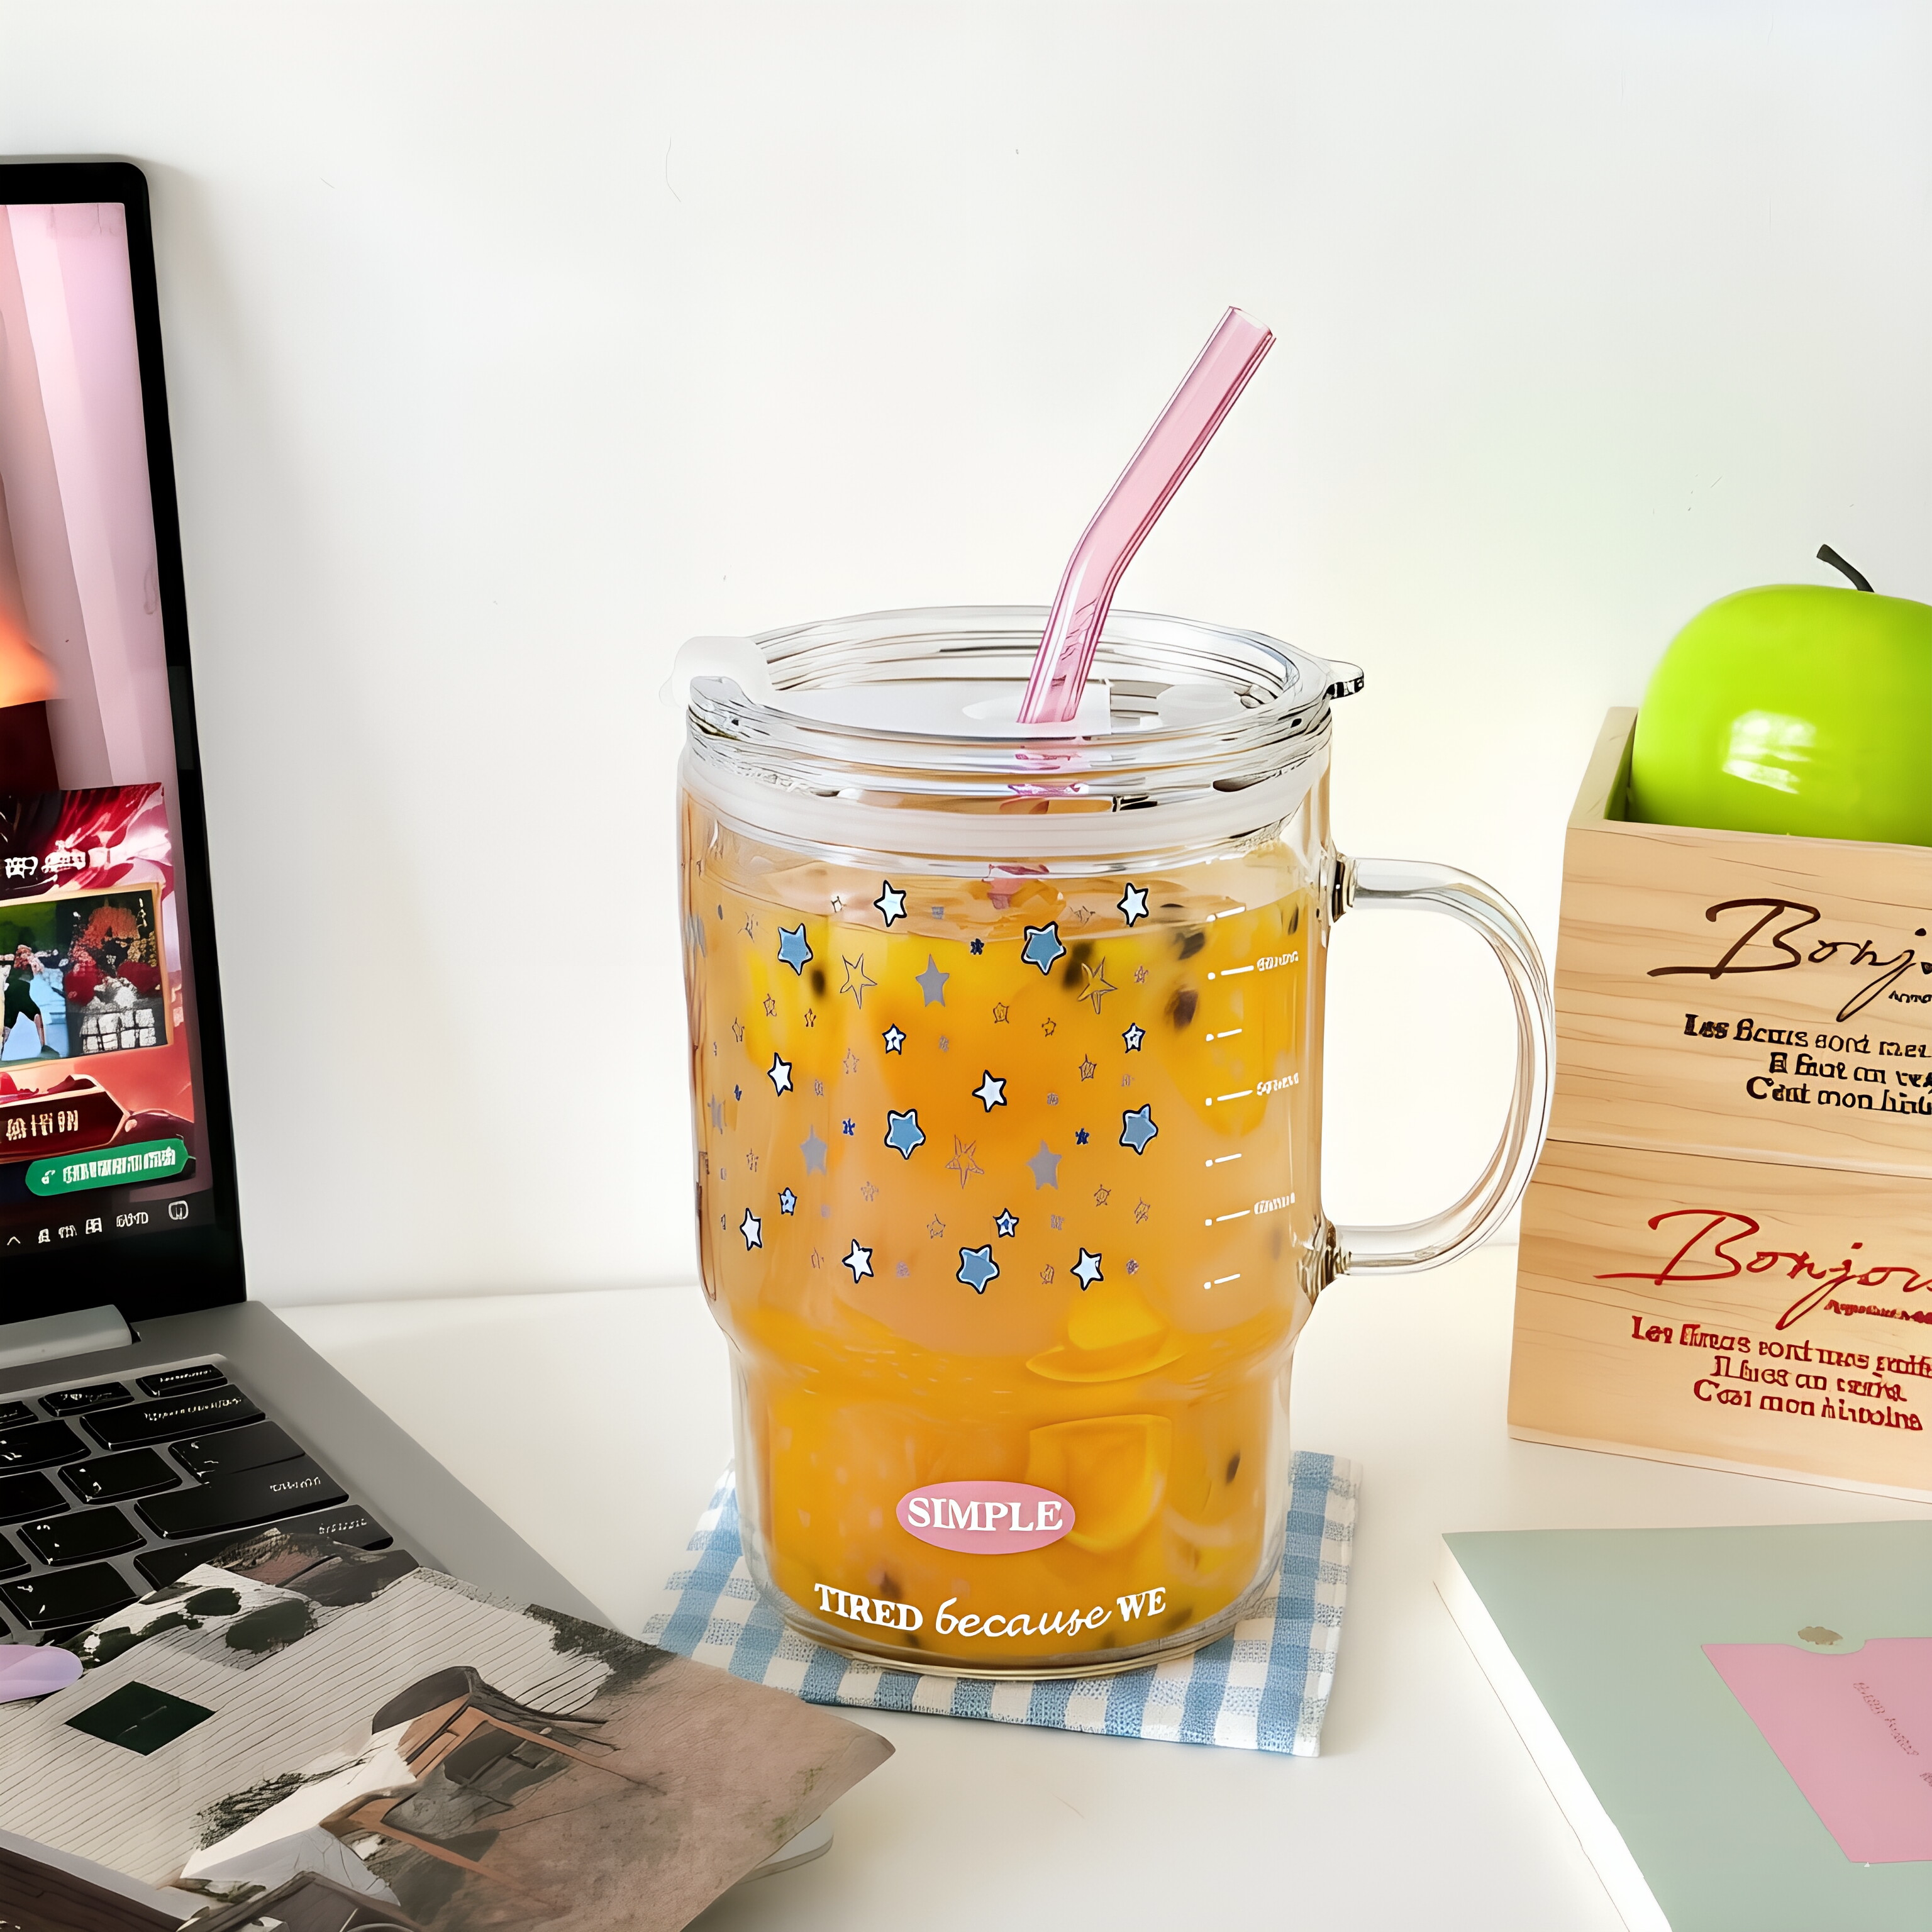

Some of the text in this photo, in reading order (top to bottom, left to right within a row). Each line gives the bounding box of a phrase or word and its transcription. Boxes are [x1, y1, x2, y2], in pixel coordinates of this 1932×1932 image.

[907, 1497, 1063, 1532] SIMPLE
[813, 1582, 1167, 1638] TIRED because WE
